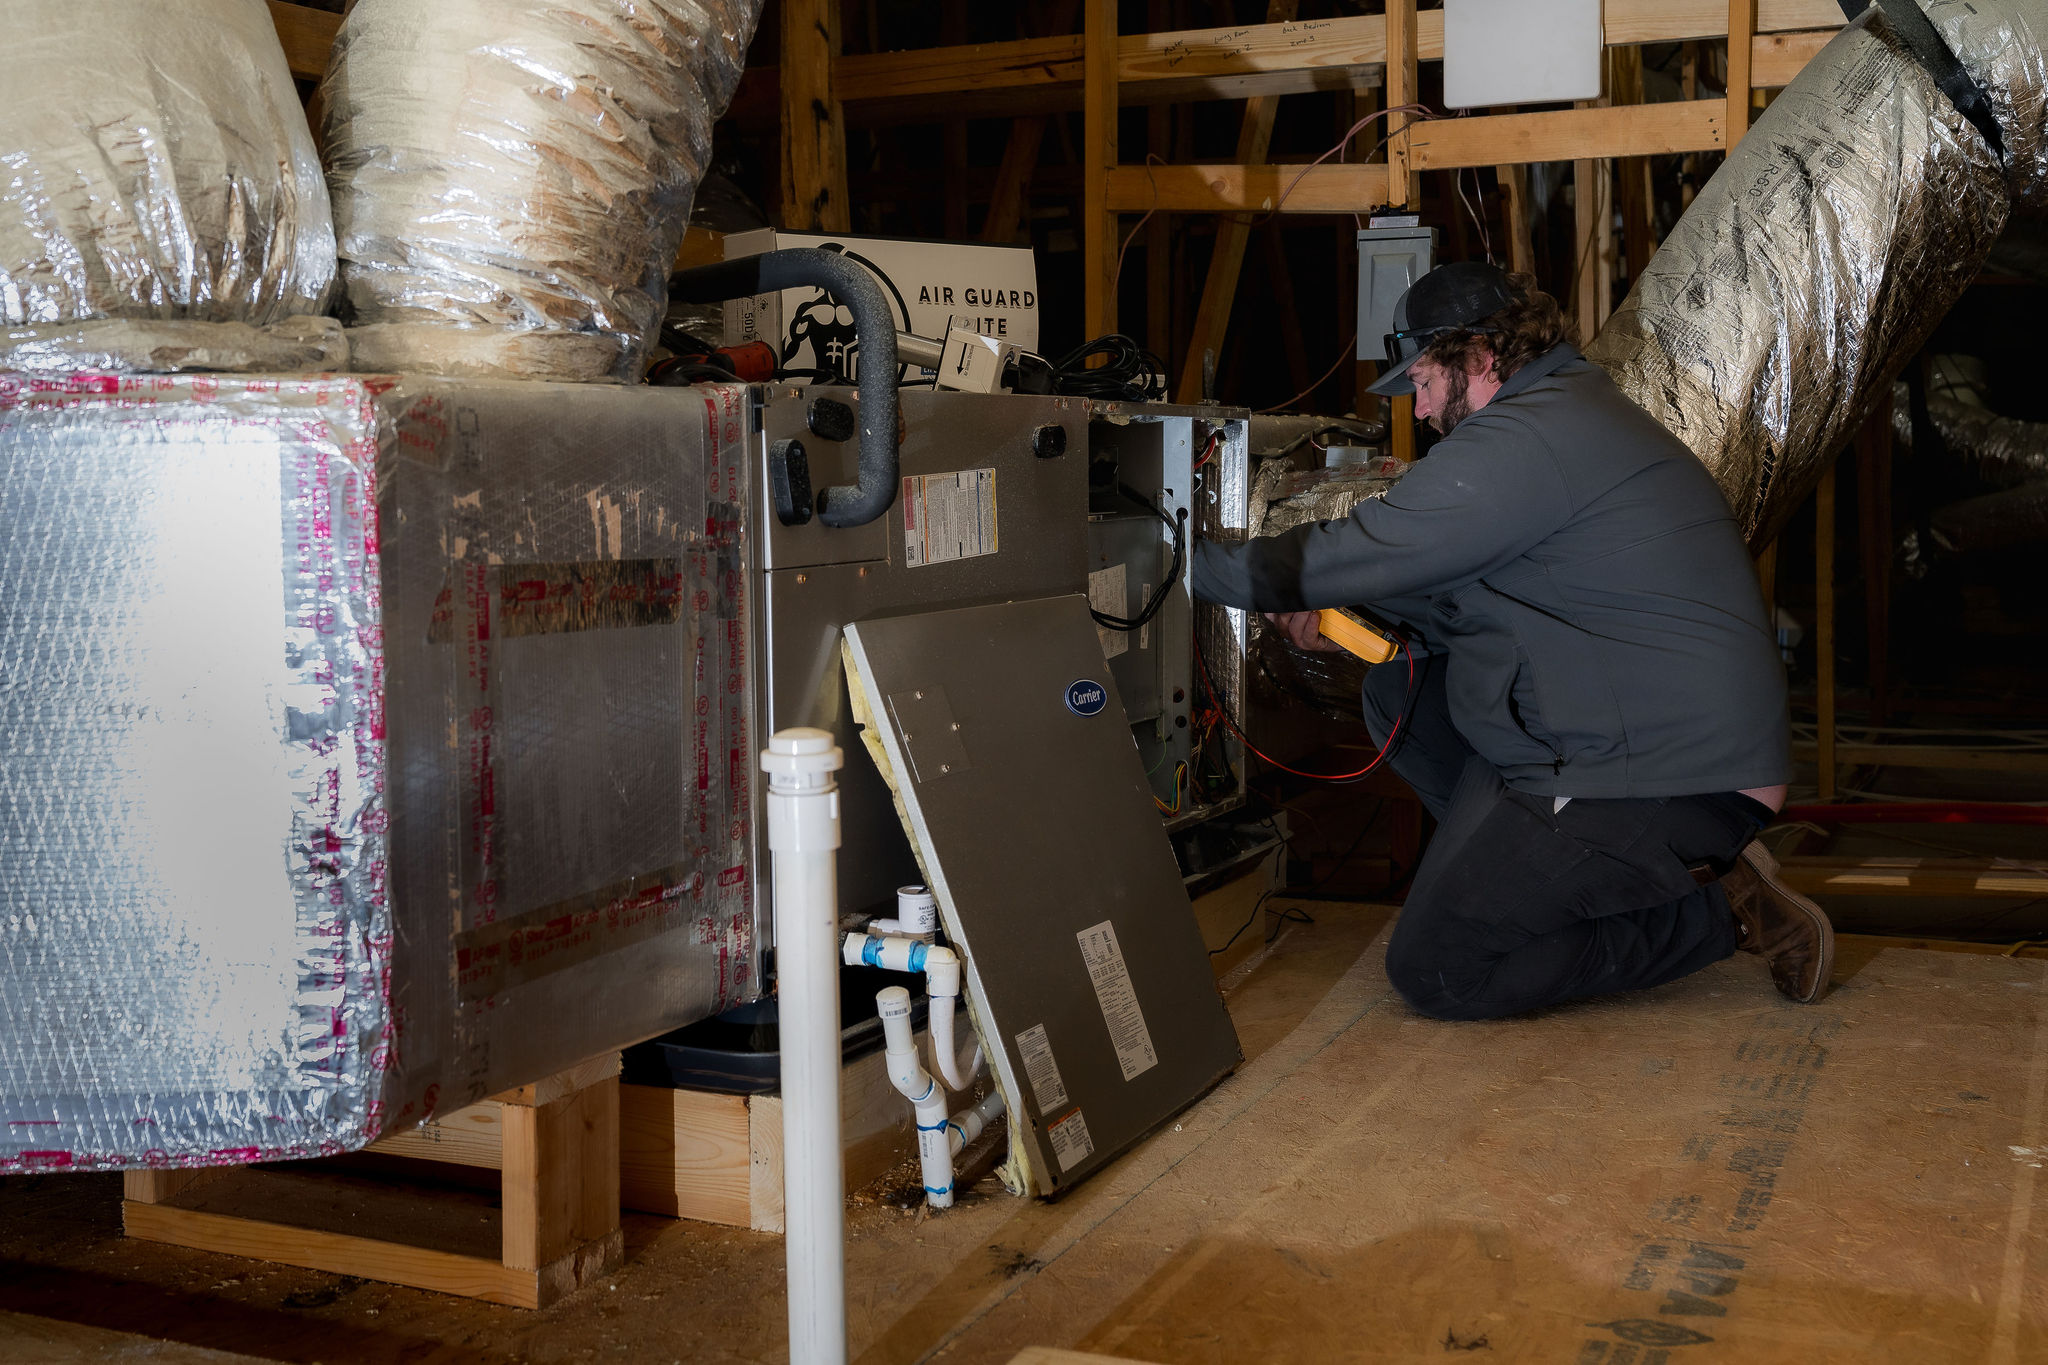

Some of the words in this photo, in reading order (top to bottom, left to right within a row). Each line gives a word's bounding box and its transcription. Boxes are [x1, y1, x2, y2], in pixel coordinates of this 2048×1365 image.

[1234, 29, 1251, 38] Room
[1282, 26, 1298, 34] Back
[1303, 22, 1331, 31] Bedroom
[1244, 43, 1254, 51] 2
[1749, 163, 1780, 196] R-6.0
[919, 285, 955, 305] AIR
[964, 287, 1036, 309] GUARD
[1072, 689, 1101, 706] Carrier
[1659, 1245, 1746, 1317] APA
